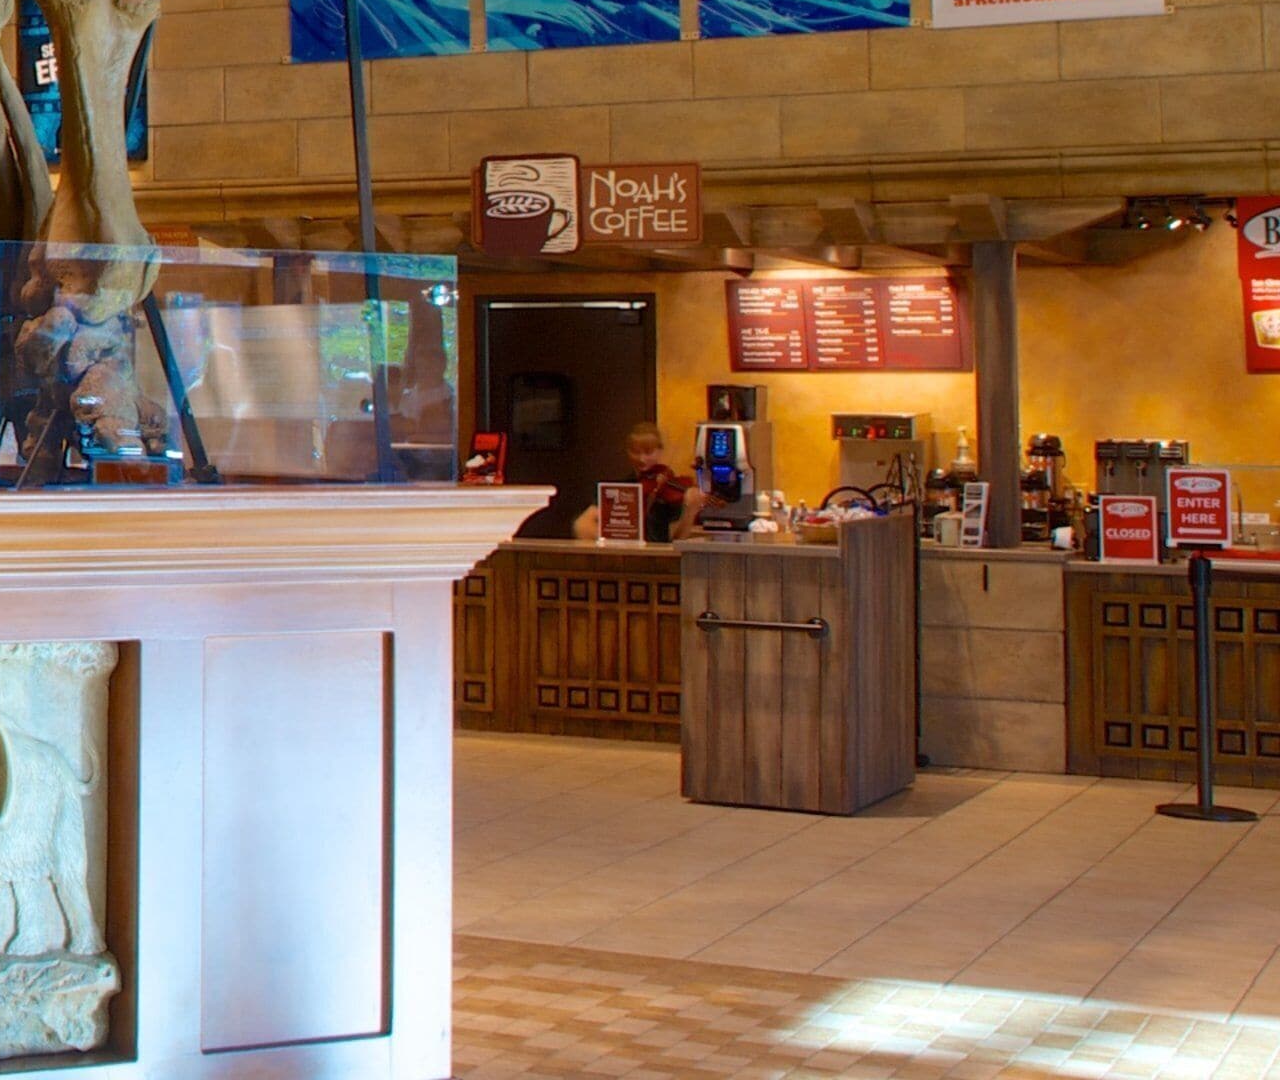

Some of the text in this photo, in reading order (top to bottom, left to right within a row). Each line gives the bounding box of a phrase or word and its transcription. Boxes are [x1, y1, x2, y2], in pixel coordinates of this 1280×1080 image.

[590, 170, 687, 209] NOAH'S
[590, 206, 689, 239] COFFEE
[1176, 497, 1220, 509] ENTER
[1181, 513, 1217, 525] HERE
[1105, 528, 1152, 540] CLOSED
